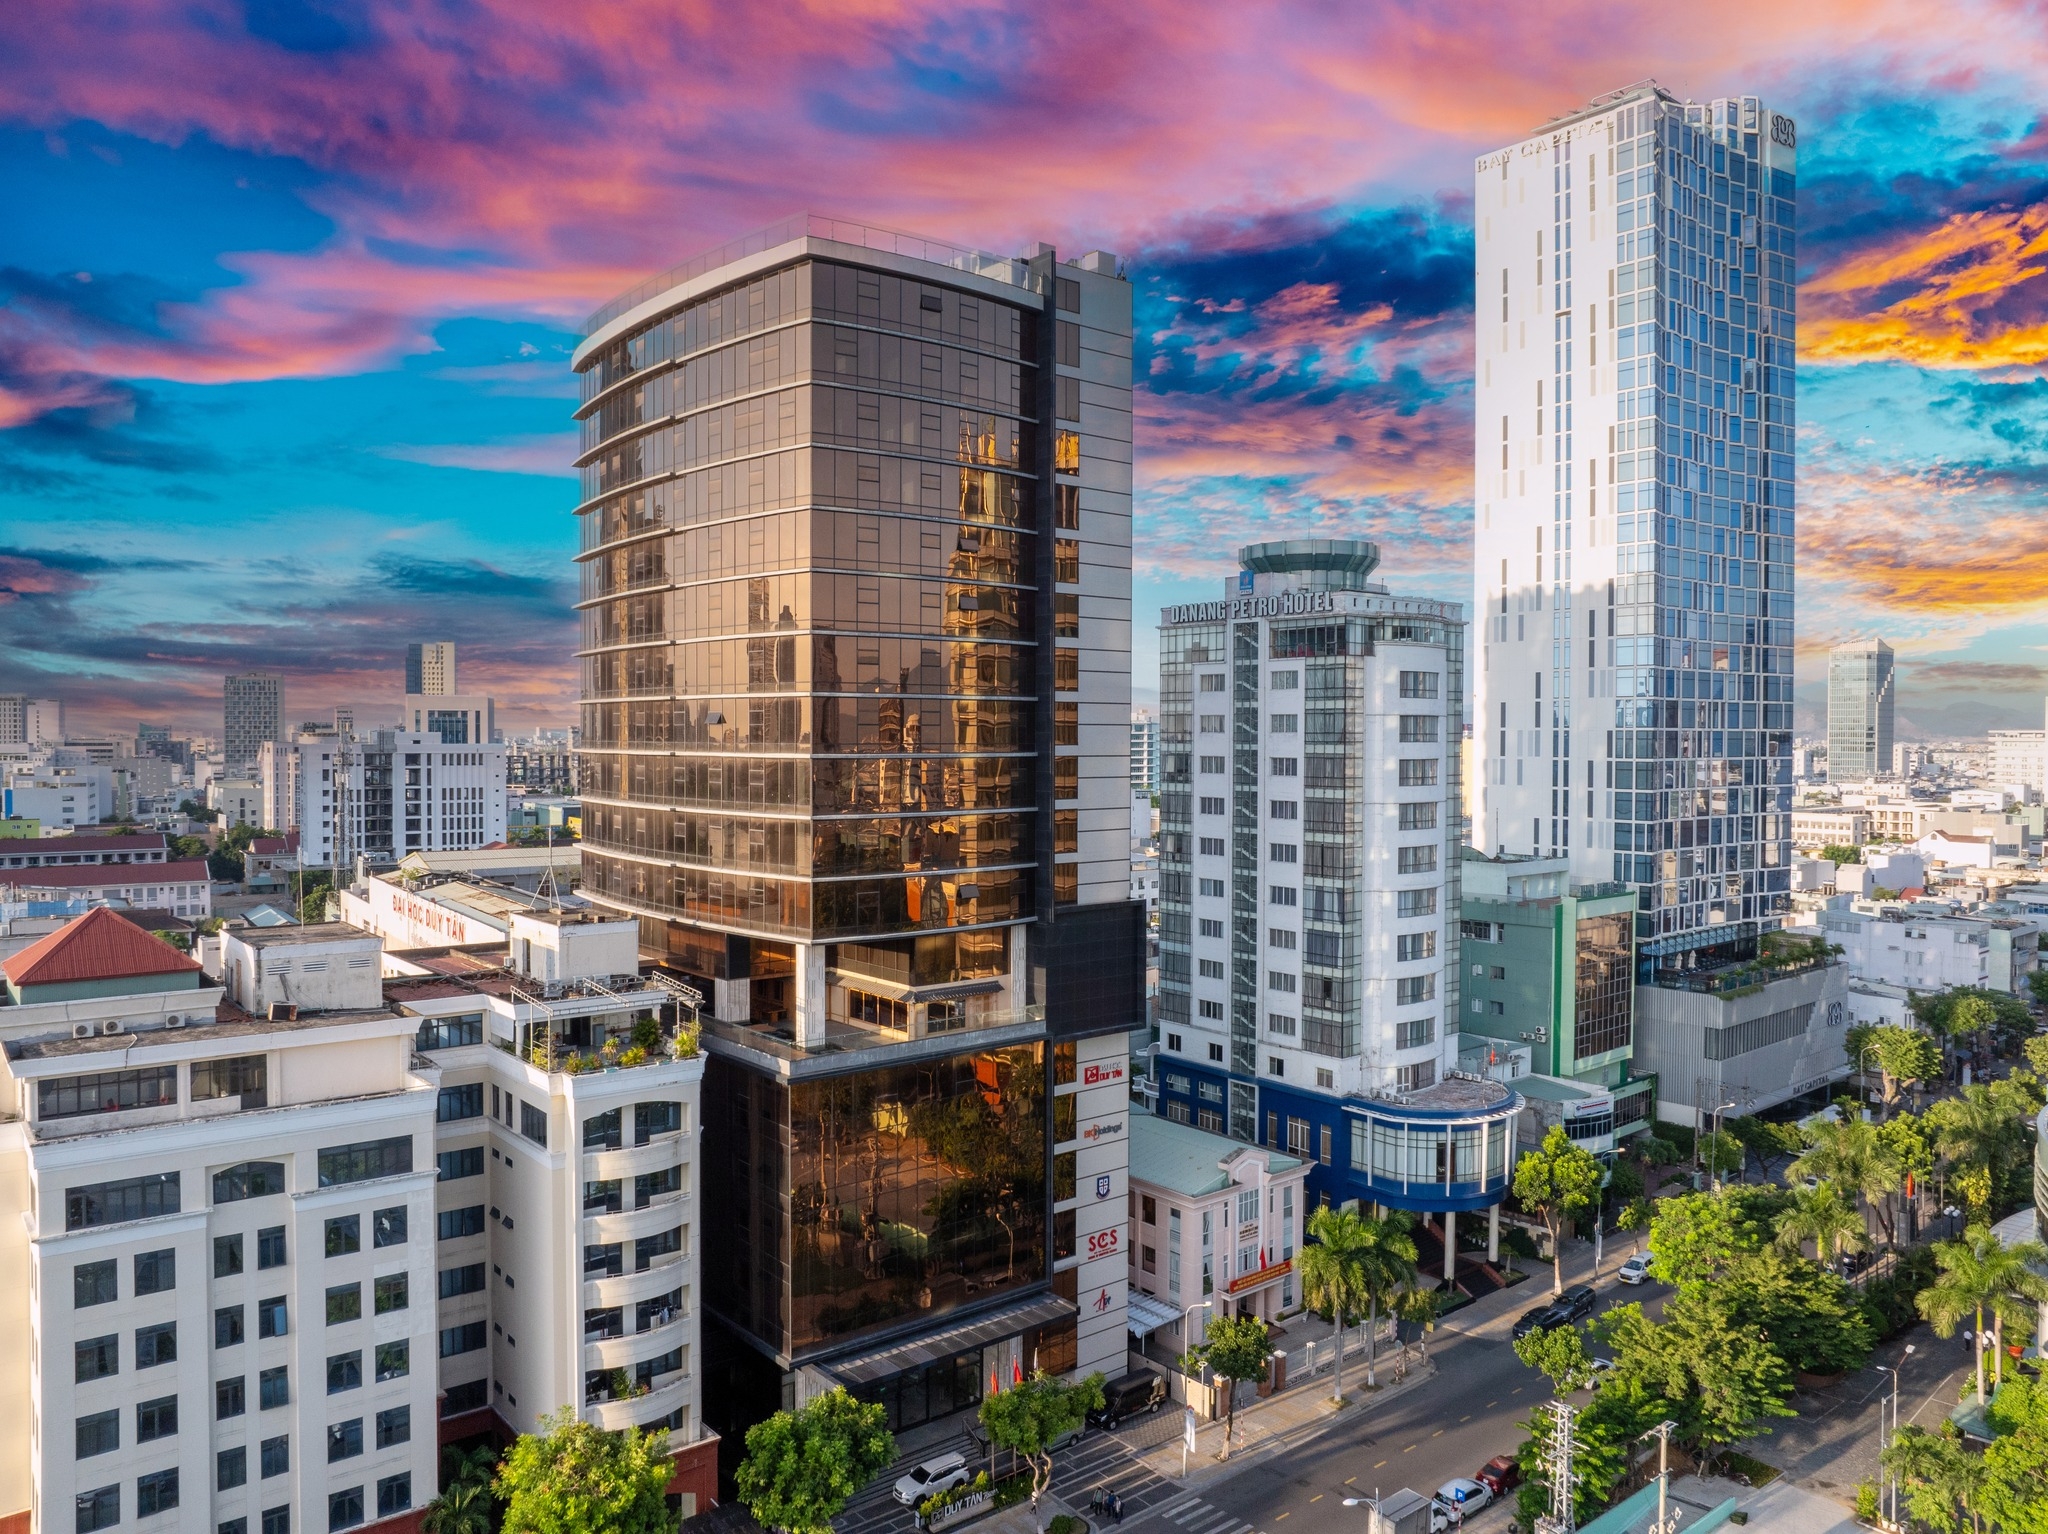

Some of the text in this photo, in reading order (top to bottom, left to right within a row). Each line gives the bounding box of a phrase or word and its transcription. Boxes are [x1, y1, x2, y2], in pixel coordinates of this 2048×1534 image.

[1477, 116, 1615, 173] BAY CAPITAL
[1170, 590, 1334, 624] DANANG PETRO HOTEL
[425, 908, 444, 934] DUY
[446, 914, 466, 943] TÂN
[1792, 1074, 1830, 1096] BAY CAPITAL
[1088, 1228, 1118, 1252] SCS
[944, 1499, 963, 1517] DUY
[964, 1491, 984, 1509] TÂN
